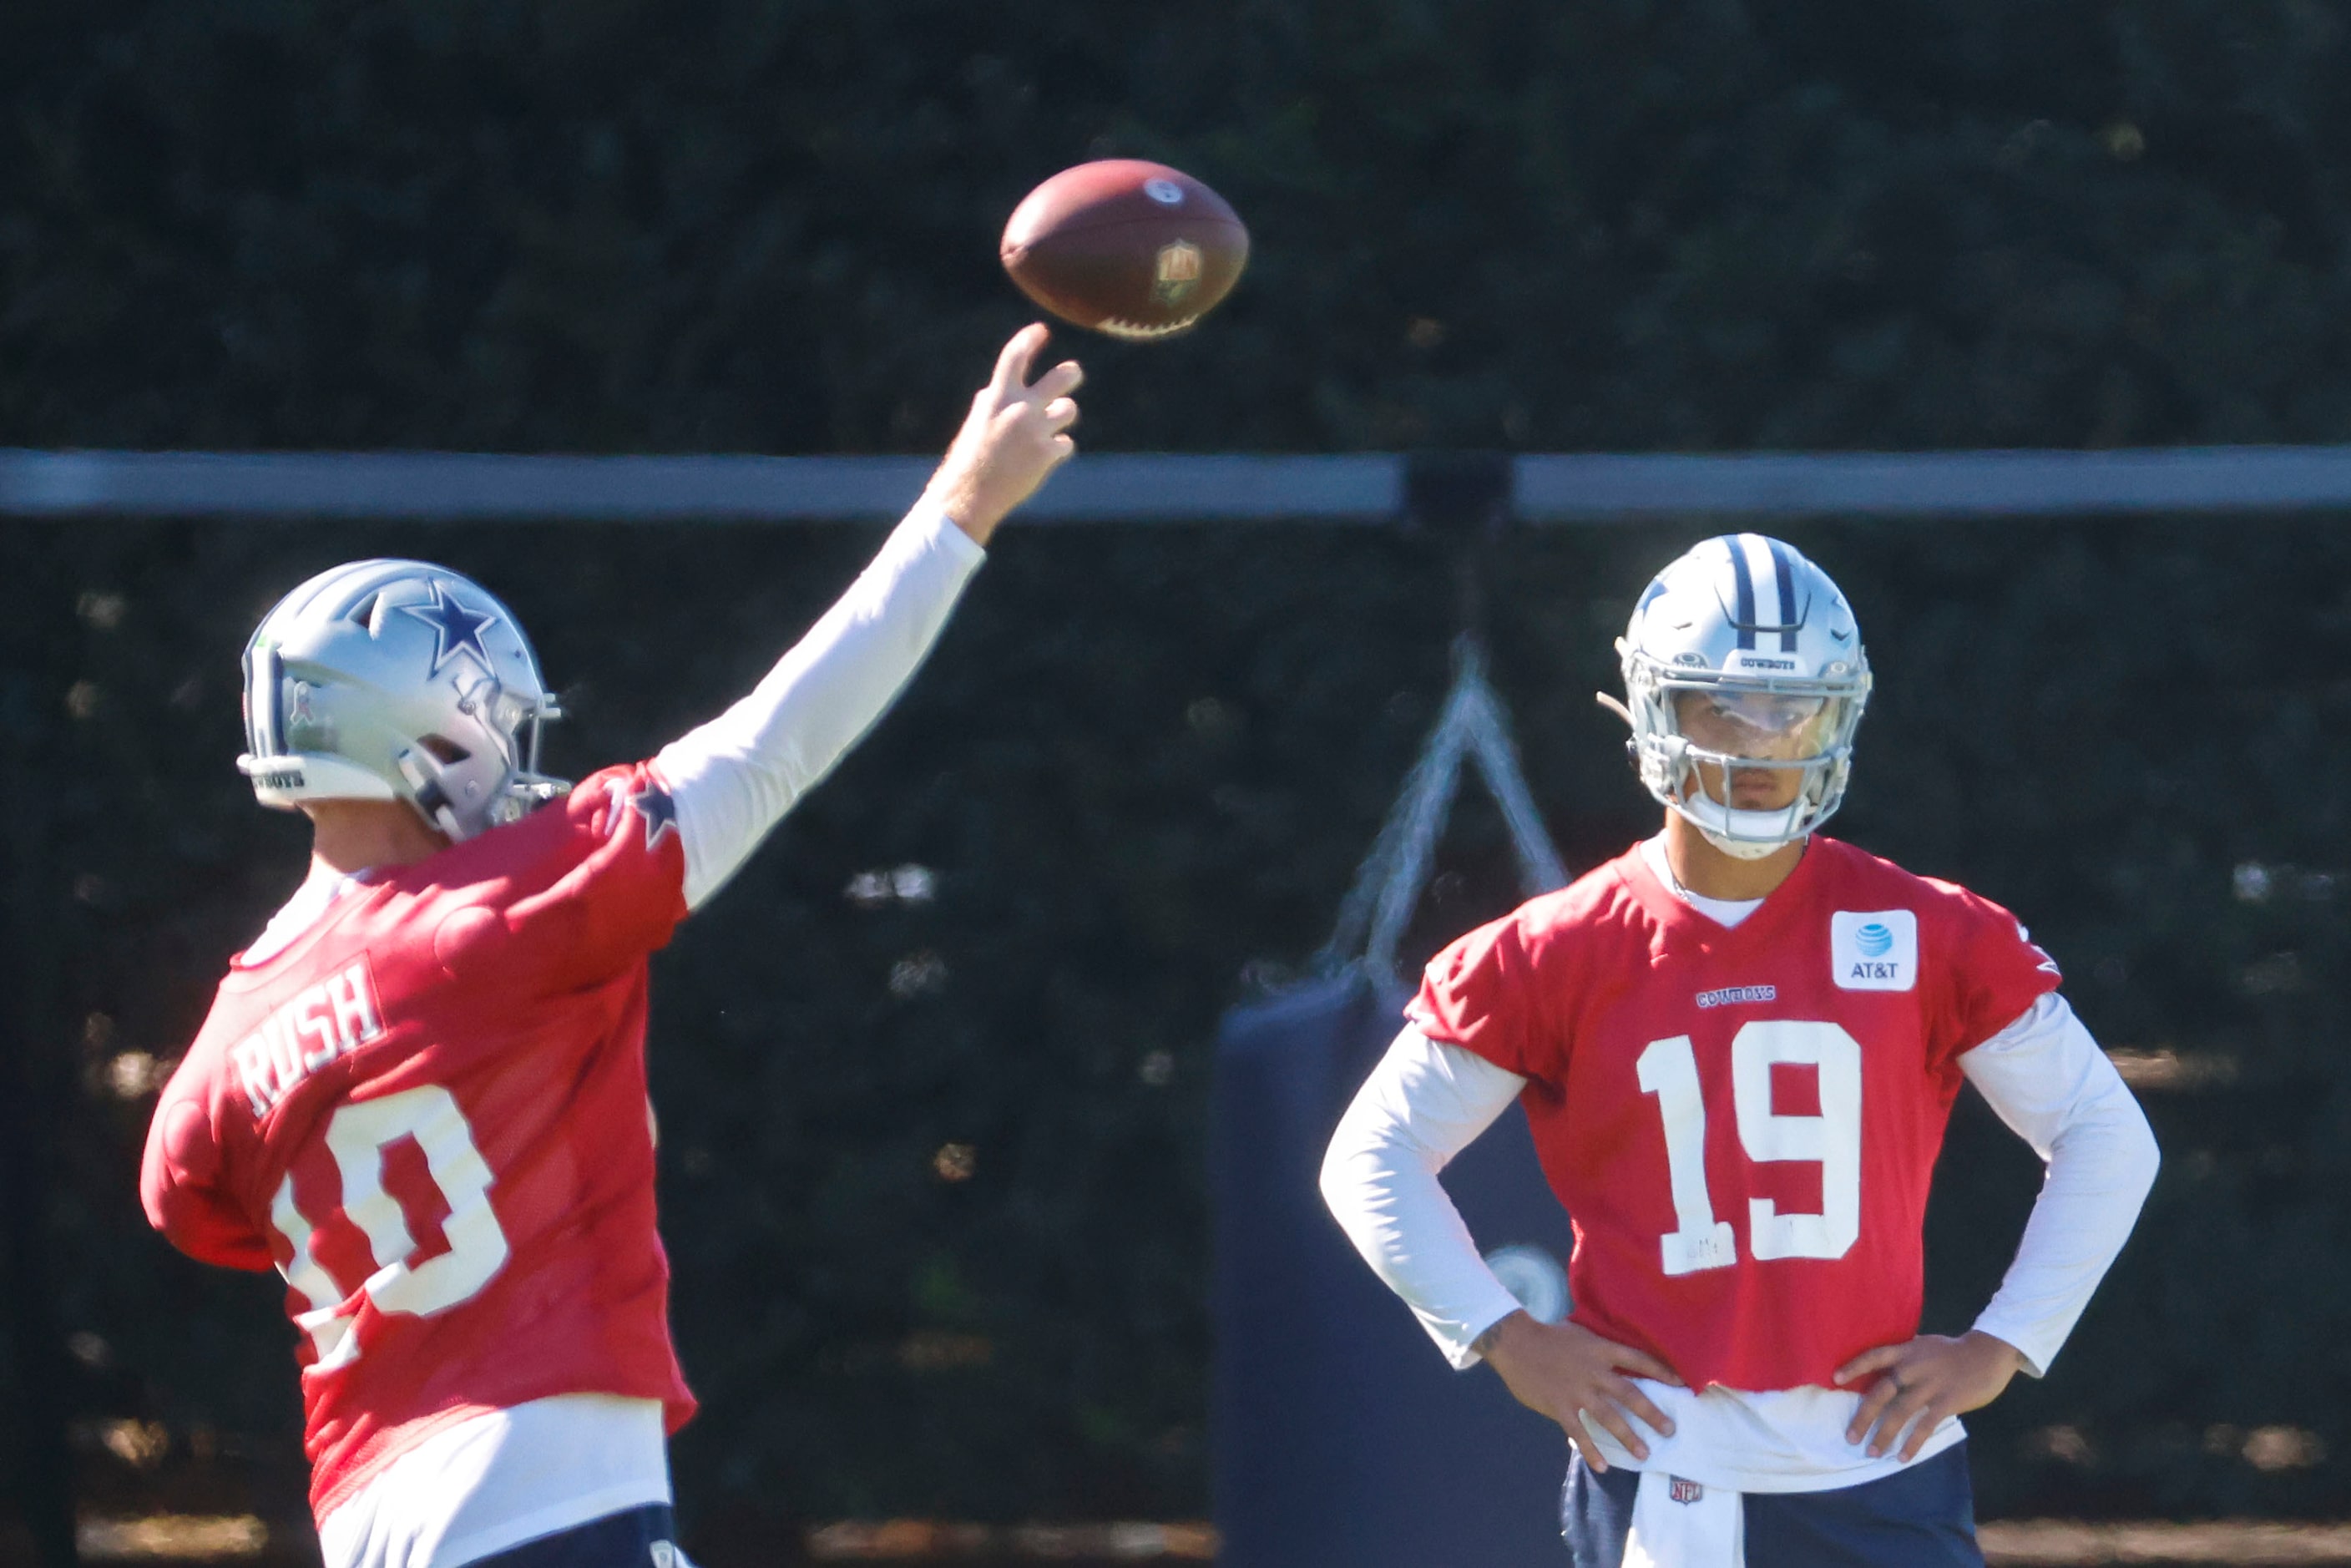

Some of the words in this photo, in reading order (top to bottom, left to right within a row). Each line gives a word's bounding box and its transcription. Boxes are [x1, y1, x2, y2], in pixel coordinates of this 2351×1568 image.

[233, 965, 382, 1117] RUSH
[1696, 985, 1776, 1008] COWBOYS
[1851, 963, 1898, 979] AT&T
[1636, 1020, 1862, 1276] 19
[270, 1084, 510, 1371] 10
